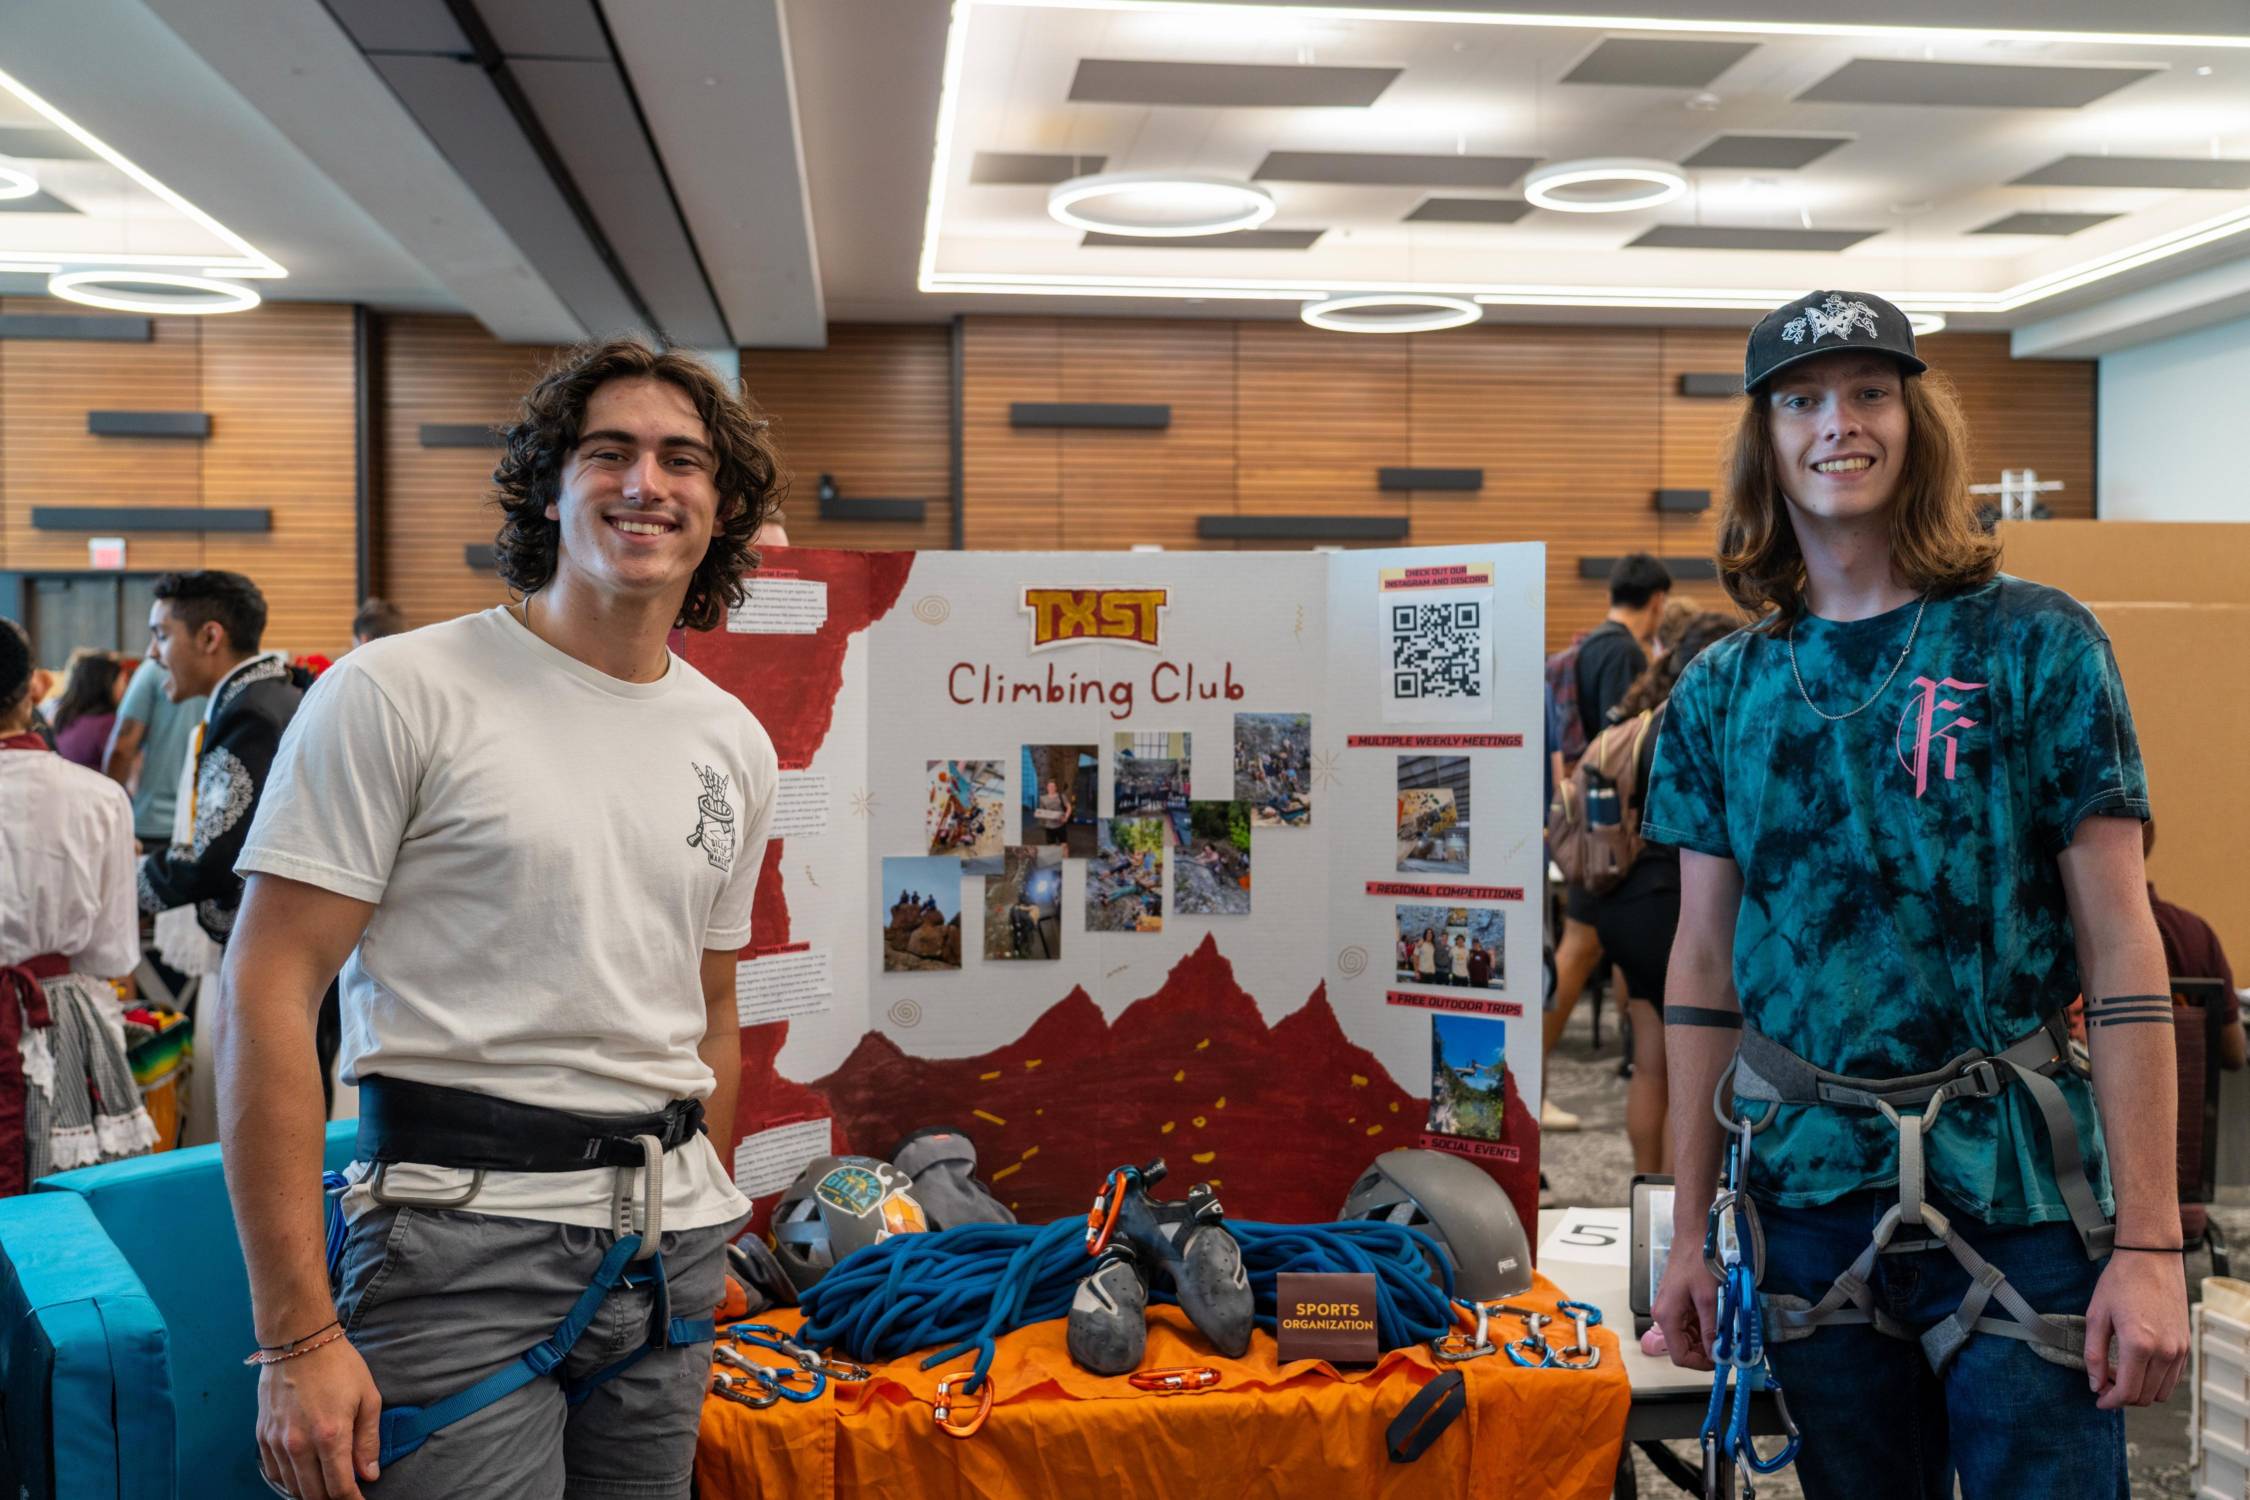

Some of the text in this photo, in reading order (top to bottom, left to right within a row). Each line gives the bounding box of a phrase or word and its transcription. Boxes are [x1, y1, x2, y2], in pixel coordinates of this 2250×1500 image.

[1405, 566, 1467, 577] CHECK OUT OUR
[1385, 578, 1430, 588] INSTAGRAM
[1432, 577, 1449, 586] AND
[1026, 589, 1167, 645] TXST
[948, 661, 1245, 720] Climbing Club
[1358, 735, 1521, 746] MULTIPLE WEEKLY MEETINGS
[1376, 884, 1522, 899] REGIONAL COMPETITIONS
[1397, 993, 1522, 1015] FREE OUTDOOR TRIPS
[1431, 1138, 1518, 1159] SOCIAL EVENTS
[1560, 1224, 1619, 1247] 5
[1296, 1303, 1360, 1316] SPORTS
[1282, 1319, 1374, 1330] ORGANIZATION
